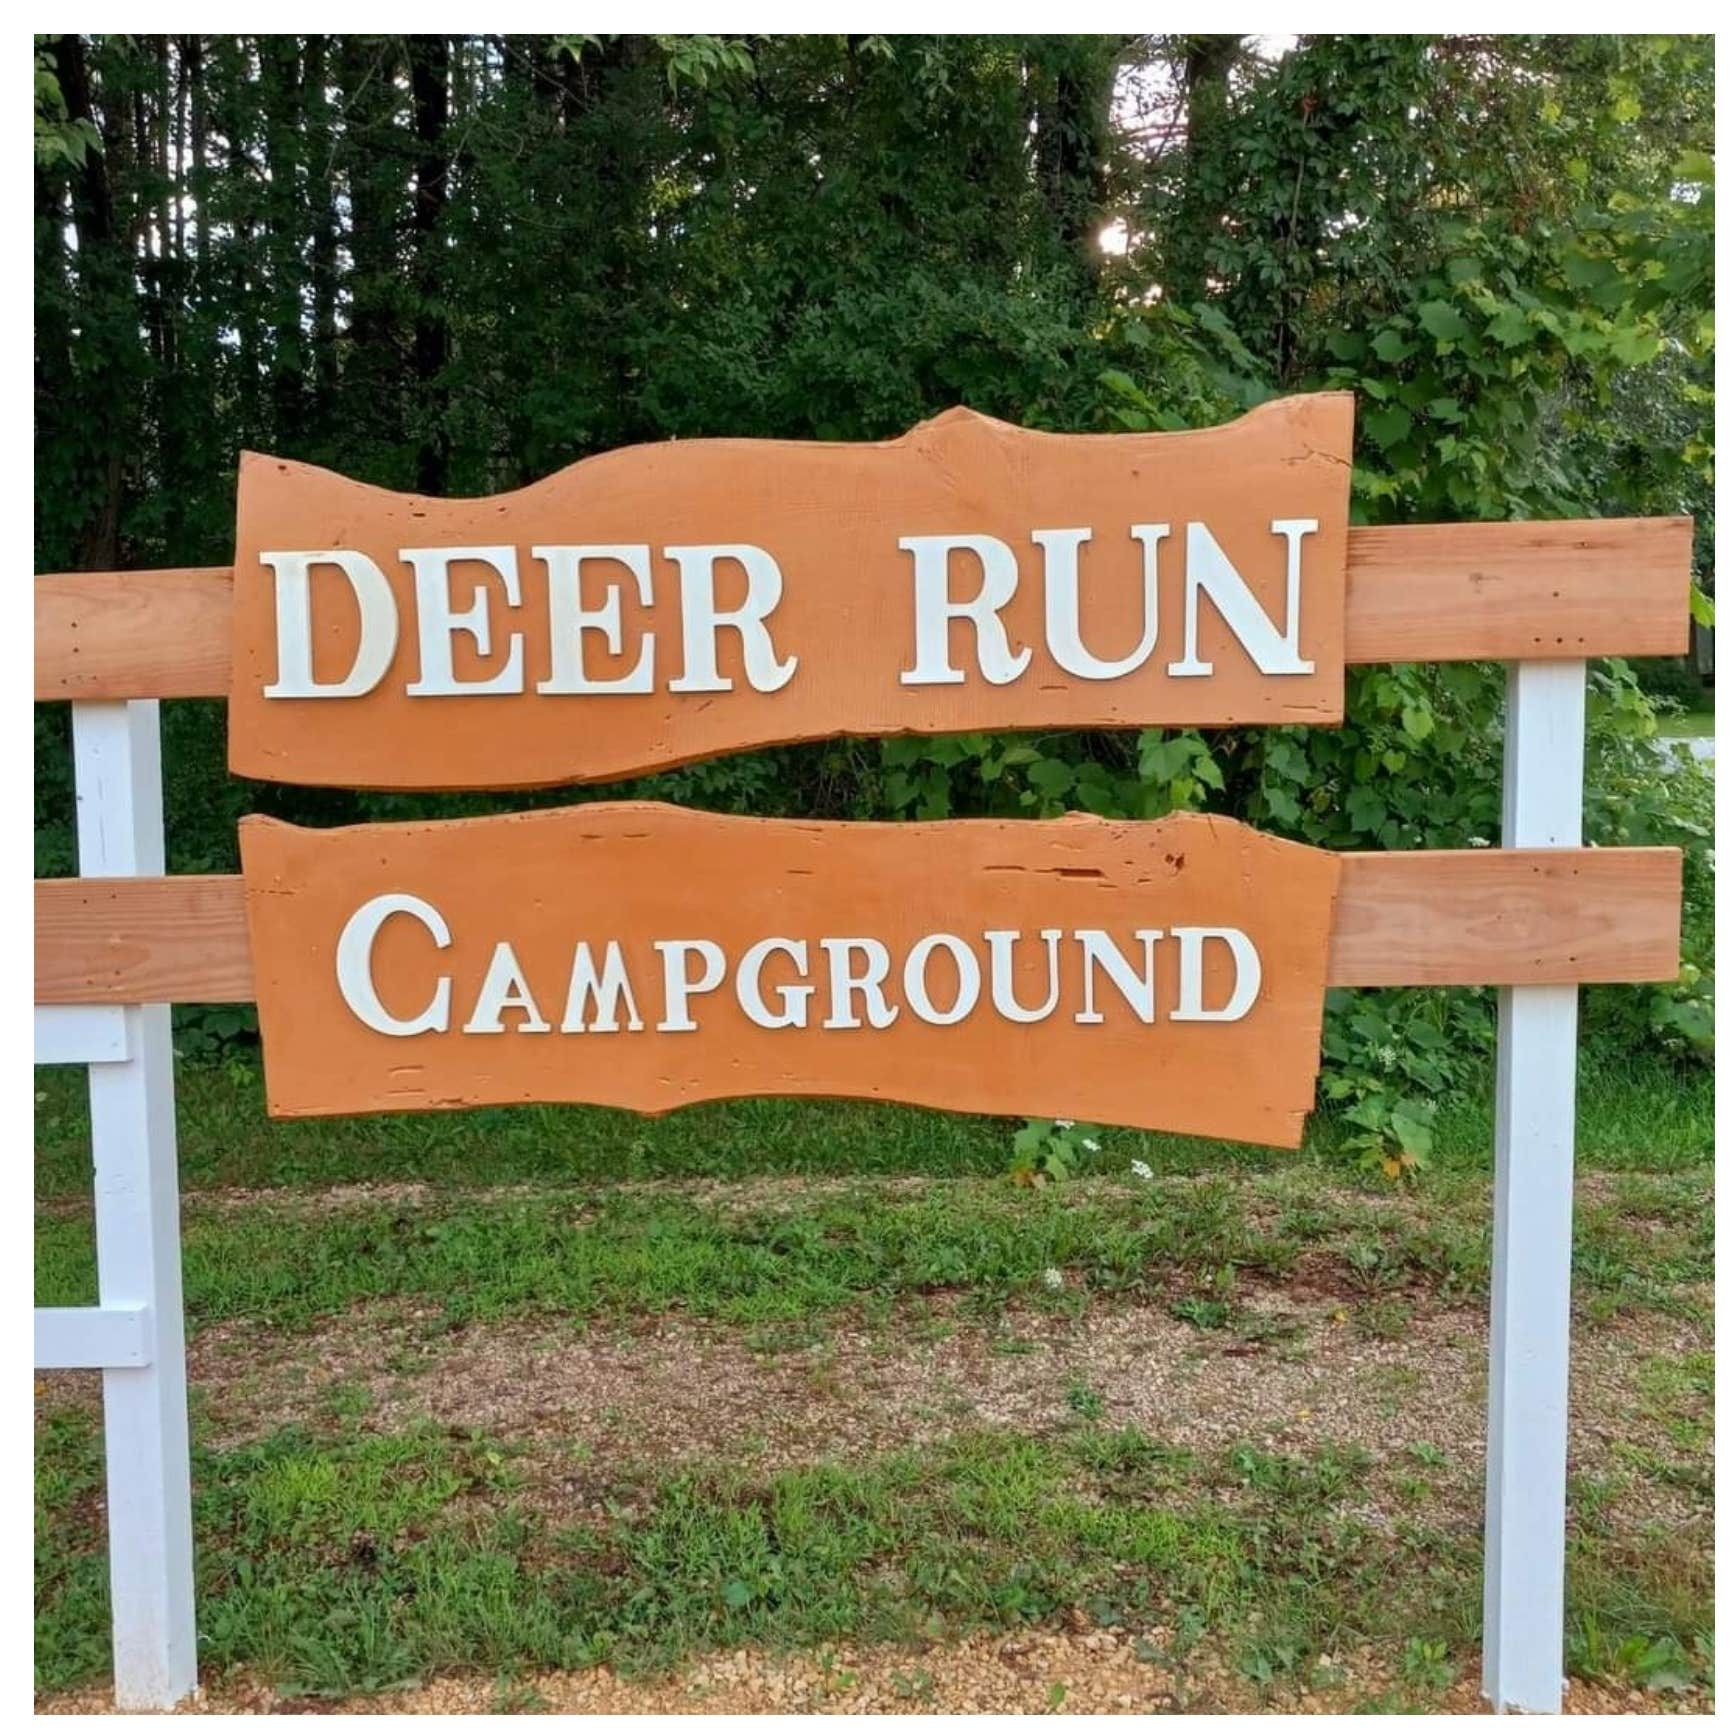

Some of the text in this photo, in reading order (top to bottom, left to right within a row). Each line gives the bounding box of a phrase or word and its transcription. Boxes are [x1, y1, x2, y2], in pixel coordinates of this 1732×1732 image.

[259, 518, 1318, 698] DEER RUN
[336, 894, 1261, 1035] CAMPGROUND
